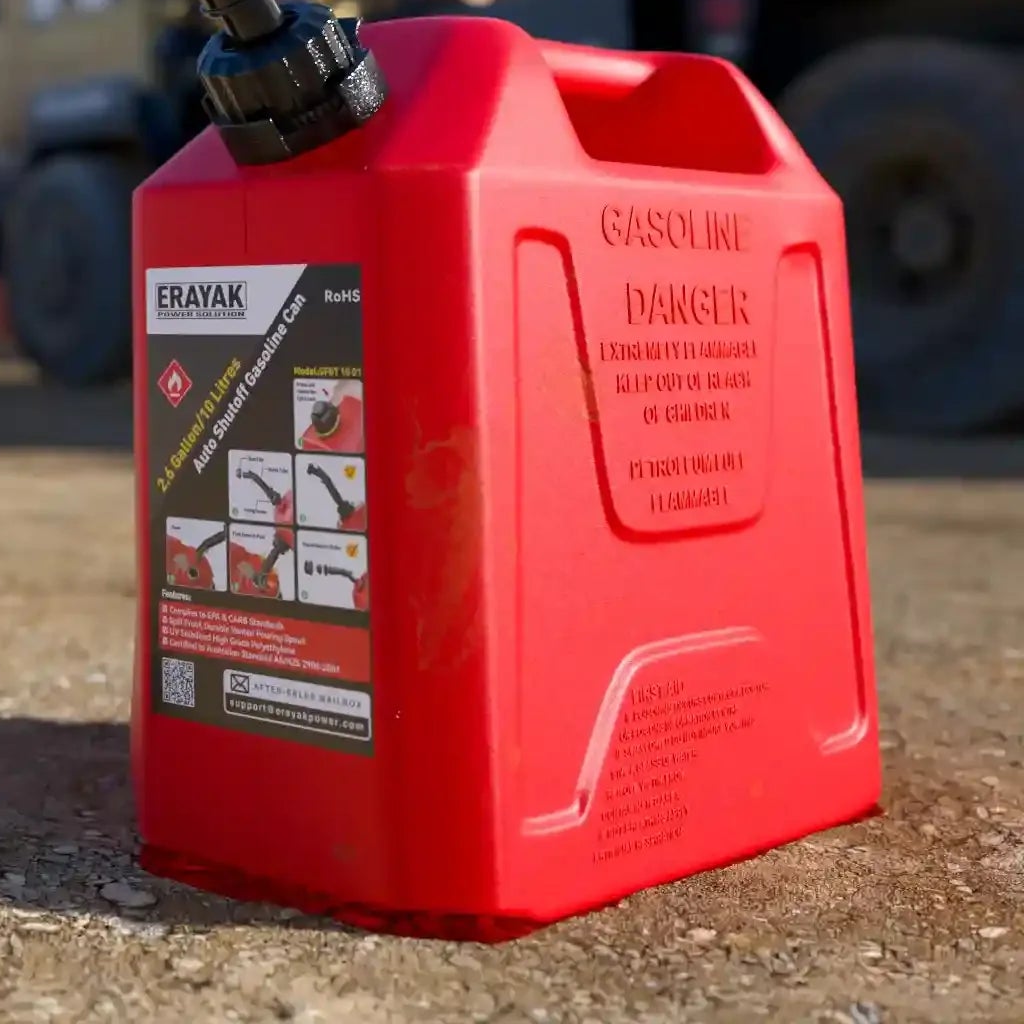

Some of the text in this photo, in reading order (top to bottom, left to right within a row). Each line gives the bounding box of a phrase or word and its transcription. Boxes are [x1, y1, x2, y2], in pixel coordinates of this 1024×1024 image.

[601, 204, 748, 252] GASOLINE
[157, 284, 244, 308] ERAYAK
[324, 288, 361, 303] RoHS
[625, 282, 750, 325] DANGER
[599, 340, 757, 361] EXTREMELY FLAMMABLE
[192, 293, 307, 474] Auto Shutoff Gasoline Can
[208, 357, 243, 404] Litres
[616, 370, 751, 394] KEEP OUT OF REACH
[642, 401, 731, 425] OF CHILDREN
[629, 452, 712, 480] PETROLEUM
[650, 485, 732, 514] FLAMMABLE
[229, 698, 366, 732] support@erayakpower.com
